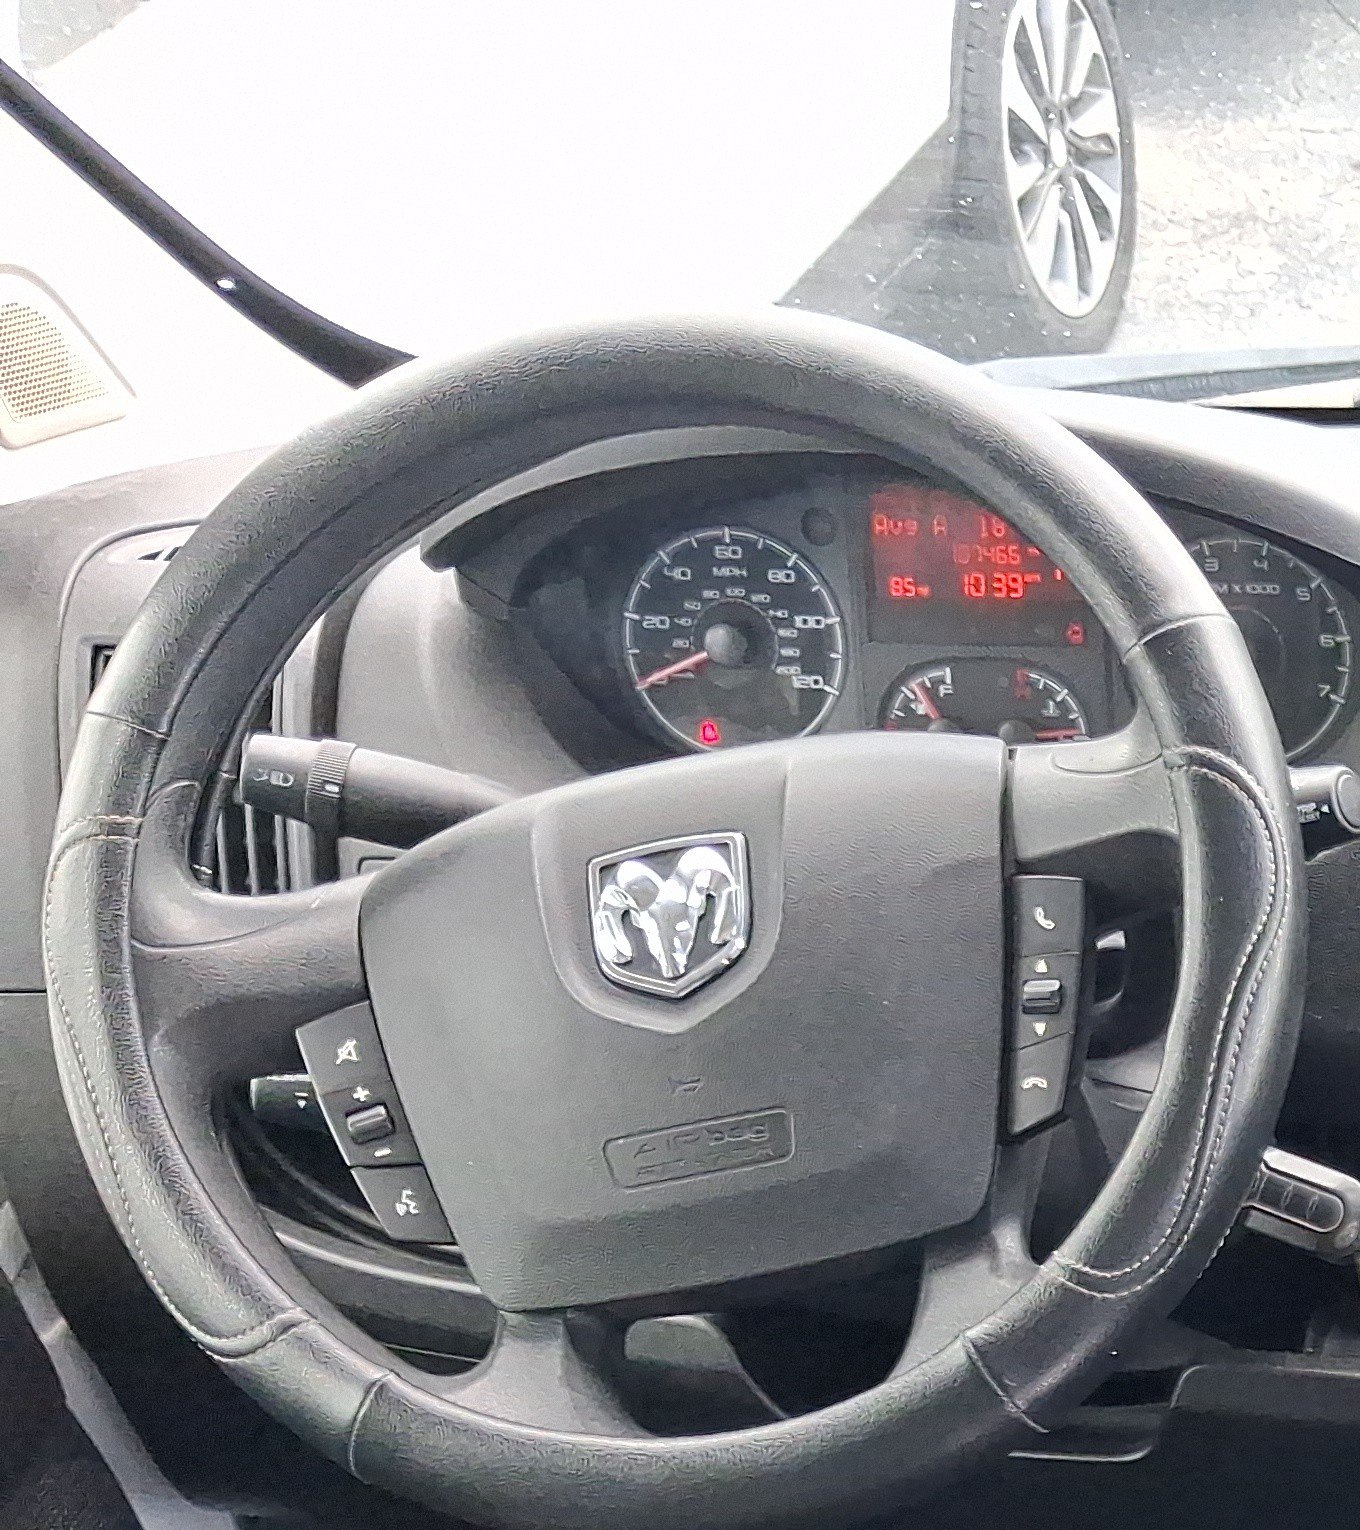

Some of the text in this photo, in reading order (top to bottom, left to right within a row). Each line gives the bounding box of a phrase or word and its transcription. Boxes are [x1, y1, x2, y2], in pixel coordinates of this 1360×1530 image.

[713, 545, 742, 559] 60
[712, 567, 747, 577] MPH
[1204, 558, 1219, 572] 3
[1253, 559, 1269, 572] 4
[664, 566, 691, 580] 40
[768, 569, 795, 583] 80
[1296, 587, 1311, 602] 5
[642, 616, 670, 629] 20
[793, 615, 825, 629] 100
[1319, 635, 1335, 647] 6
[792, 675, 824, 689] 120
[1318, 684, 1331, 697] 7
